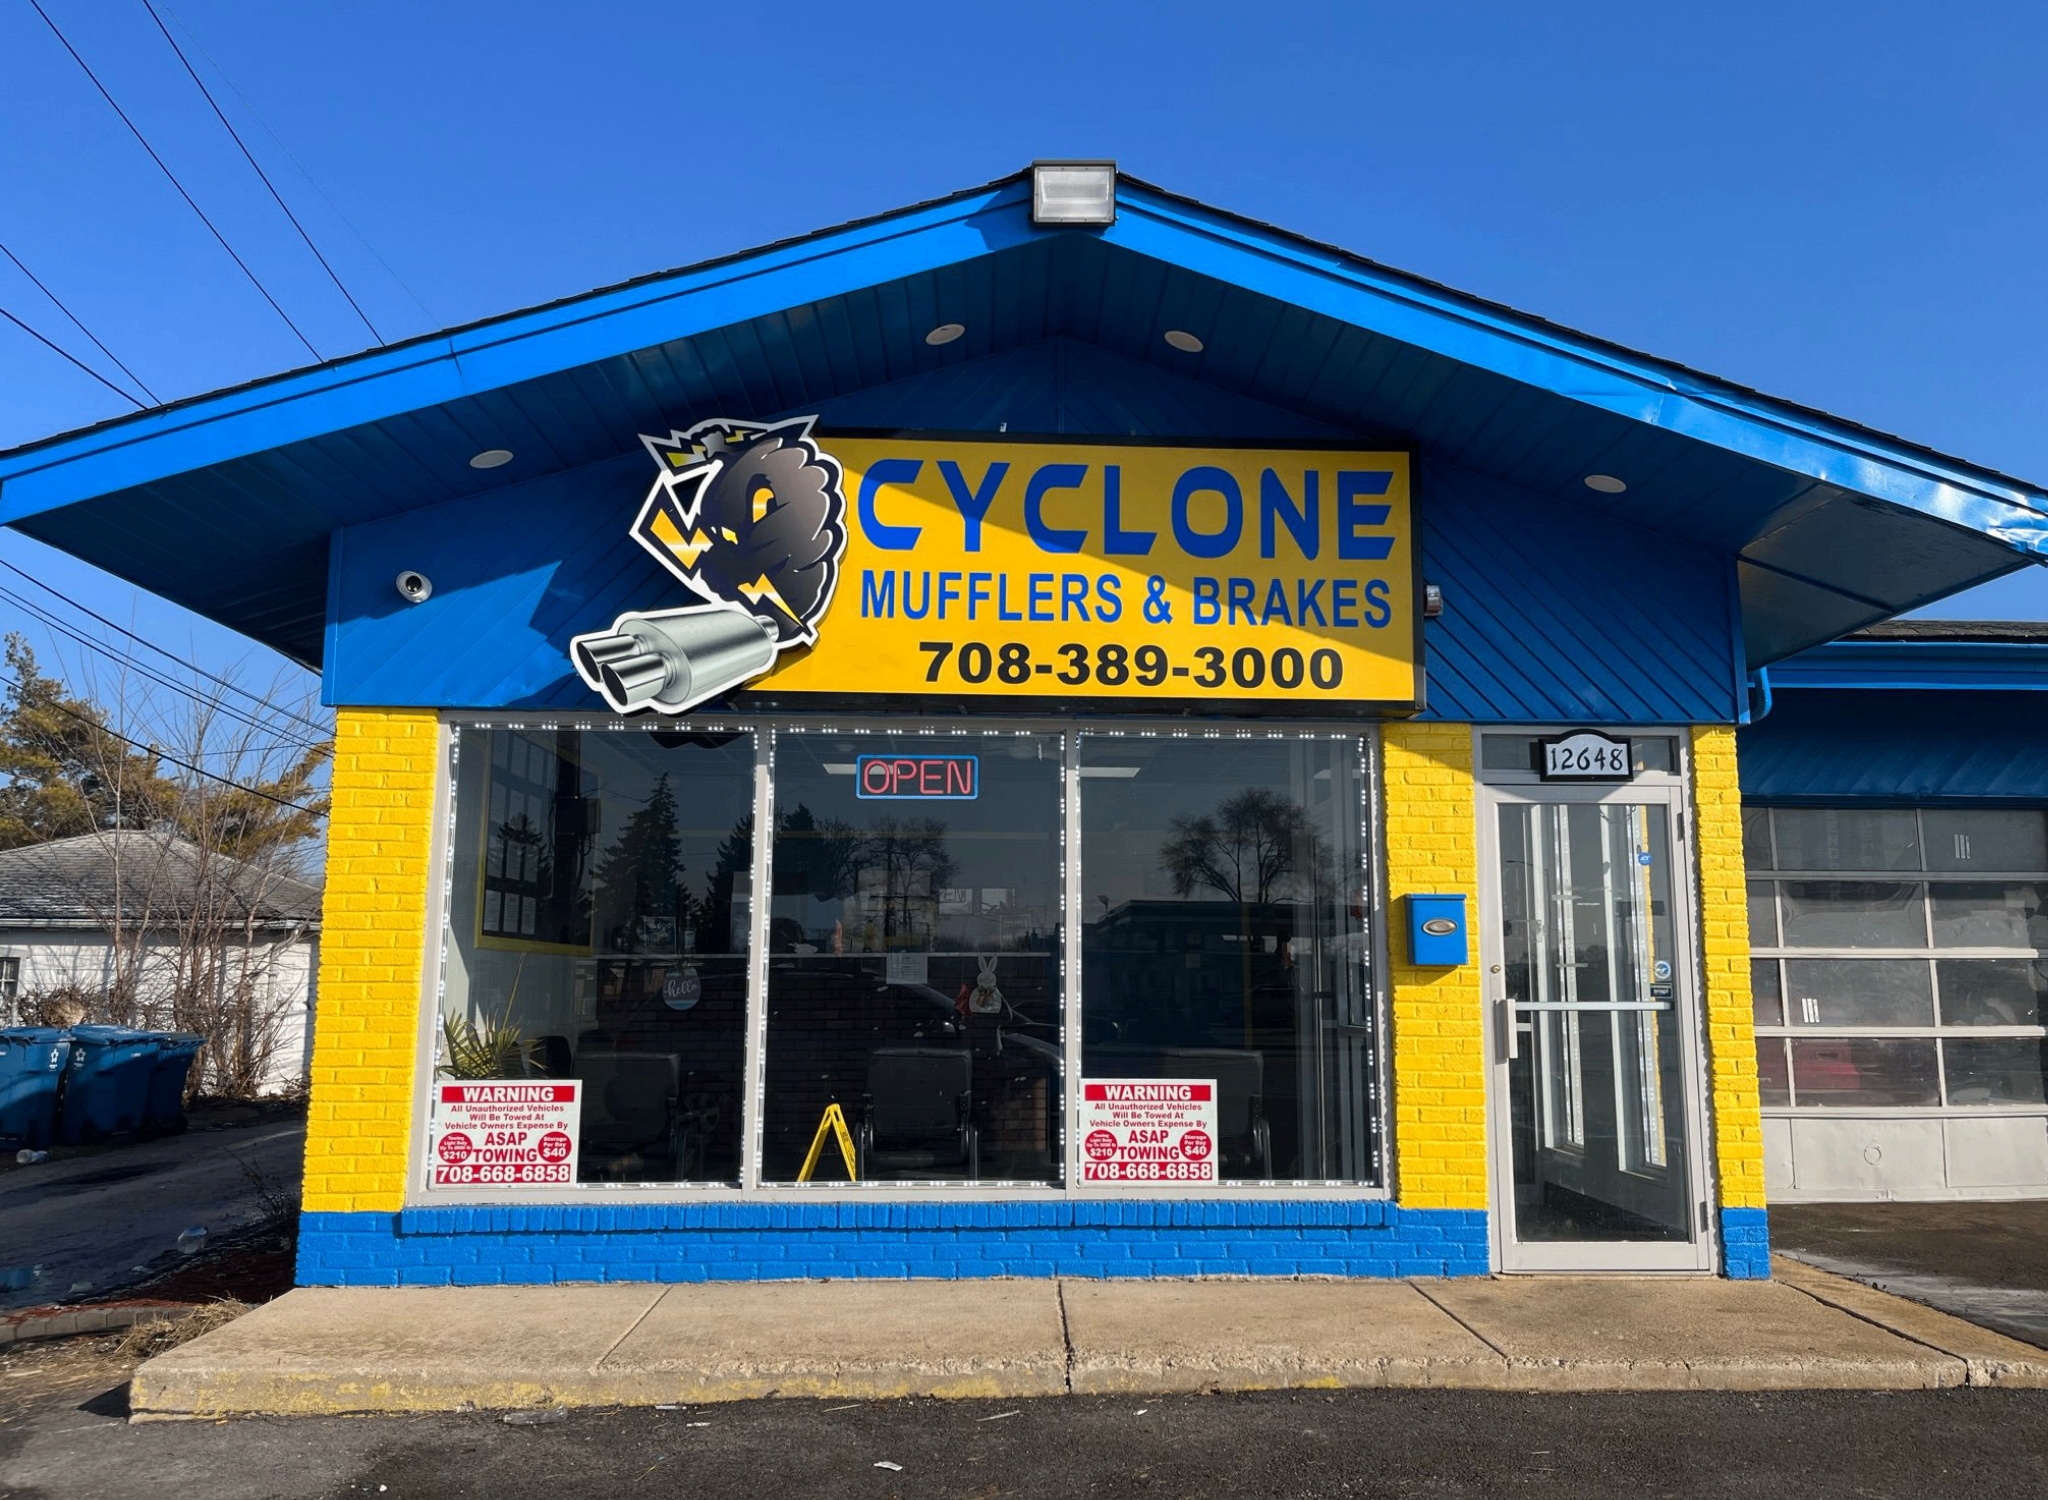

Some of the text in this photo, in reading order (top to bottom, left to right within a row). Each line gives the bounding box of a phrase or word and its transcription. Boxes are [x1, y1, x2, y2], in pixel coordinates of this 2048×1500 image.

[857, 458, 1396, 561] CYCLONE
[861, 569, 1392, 629] MUFFLERS & BRAKES
[919, 641, 1344, 690] 708-389-3000
[1550, 746, 1624, 771] 12648
[863, 759, 972, 794] OPEN
[462, 1086, 555, 1102] WARNING
[1104, 1085, 1192, 1100] WARNING
[451, 1104, 564, 1113] All Unauthorized Vehicles
[469, 1113, 544, 1121] Will Be Towed At
[445, 1121, 568, 1130] Vehicle Owners Expense By
[1089, 1120, 1207, 1129] Vehicle Owners Expense By
[484, 1132, 527, 1146] ASAP
[1128, 1130, 1169, 1144] ASAP
[443, 1150, 467, 1160] $210
[473, 1148, 538, 1163] TOWING
[543, 1147, 566, 1158] $40
[1090, 1147, 1113, 1157] $210
[1117, 1146, 1180, 1160] TOWING
[1184, 1145, 1207, 1157] $40
[437, 1165, 569, 1183] 708-668-6858
[1085, 1162, 1211, 1180] 708-668-6858
